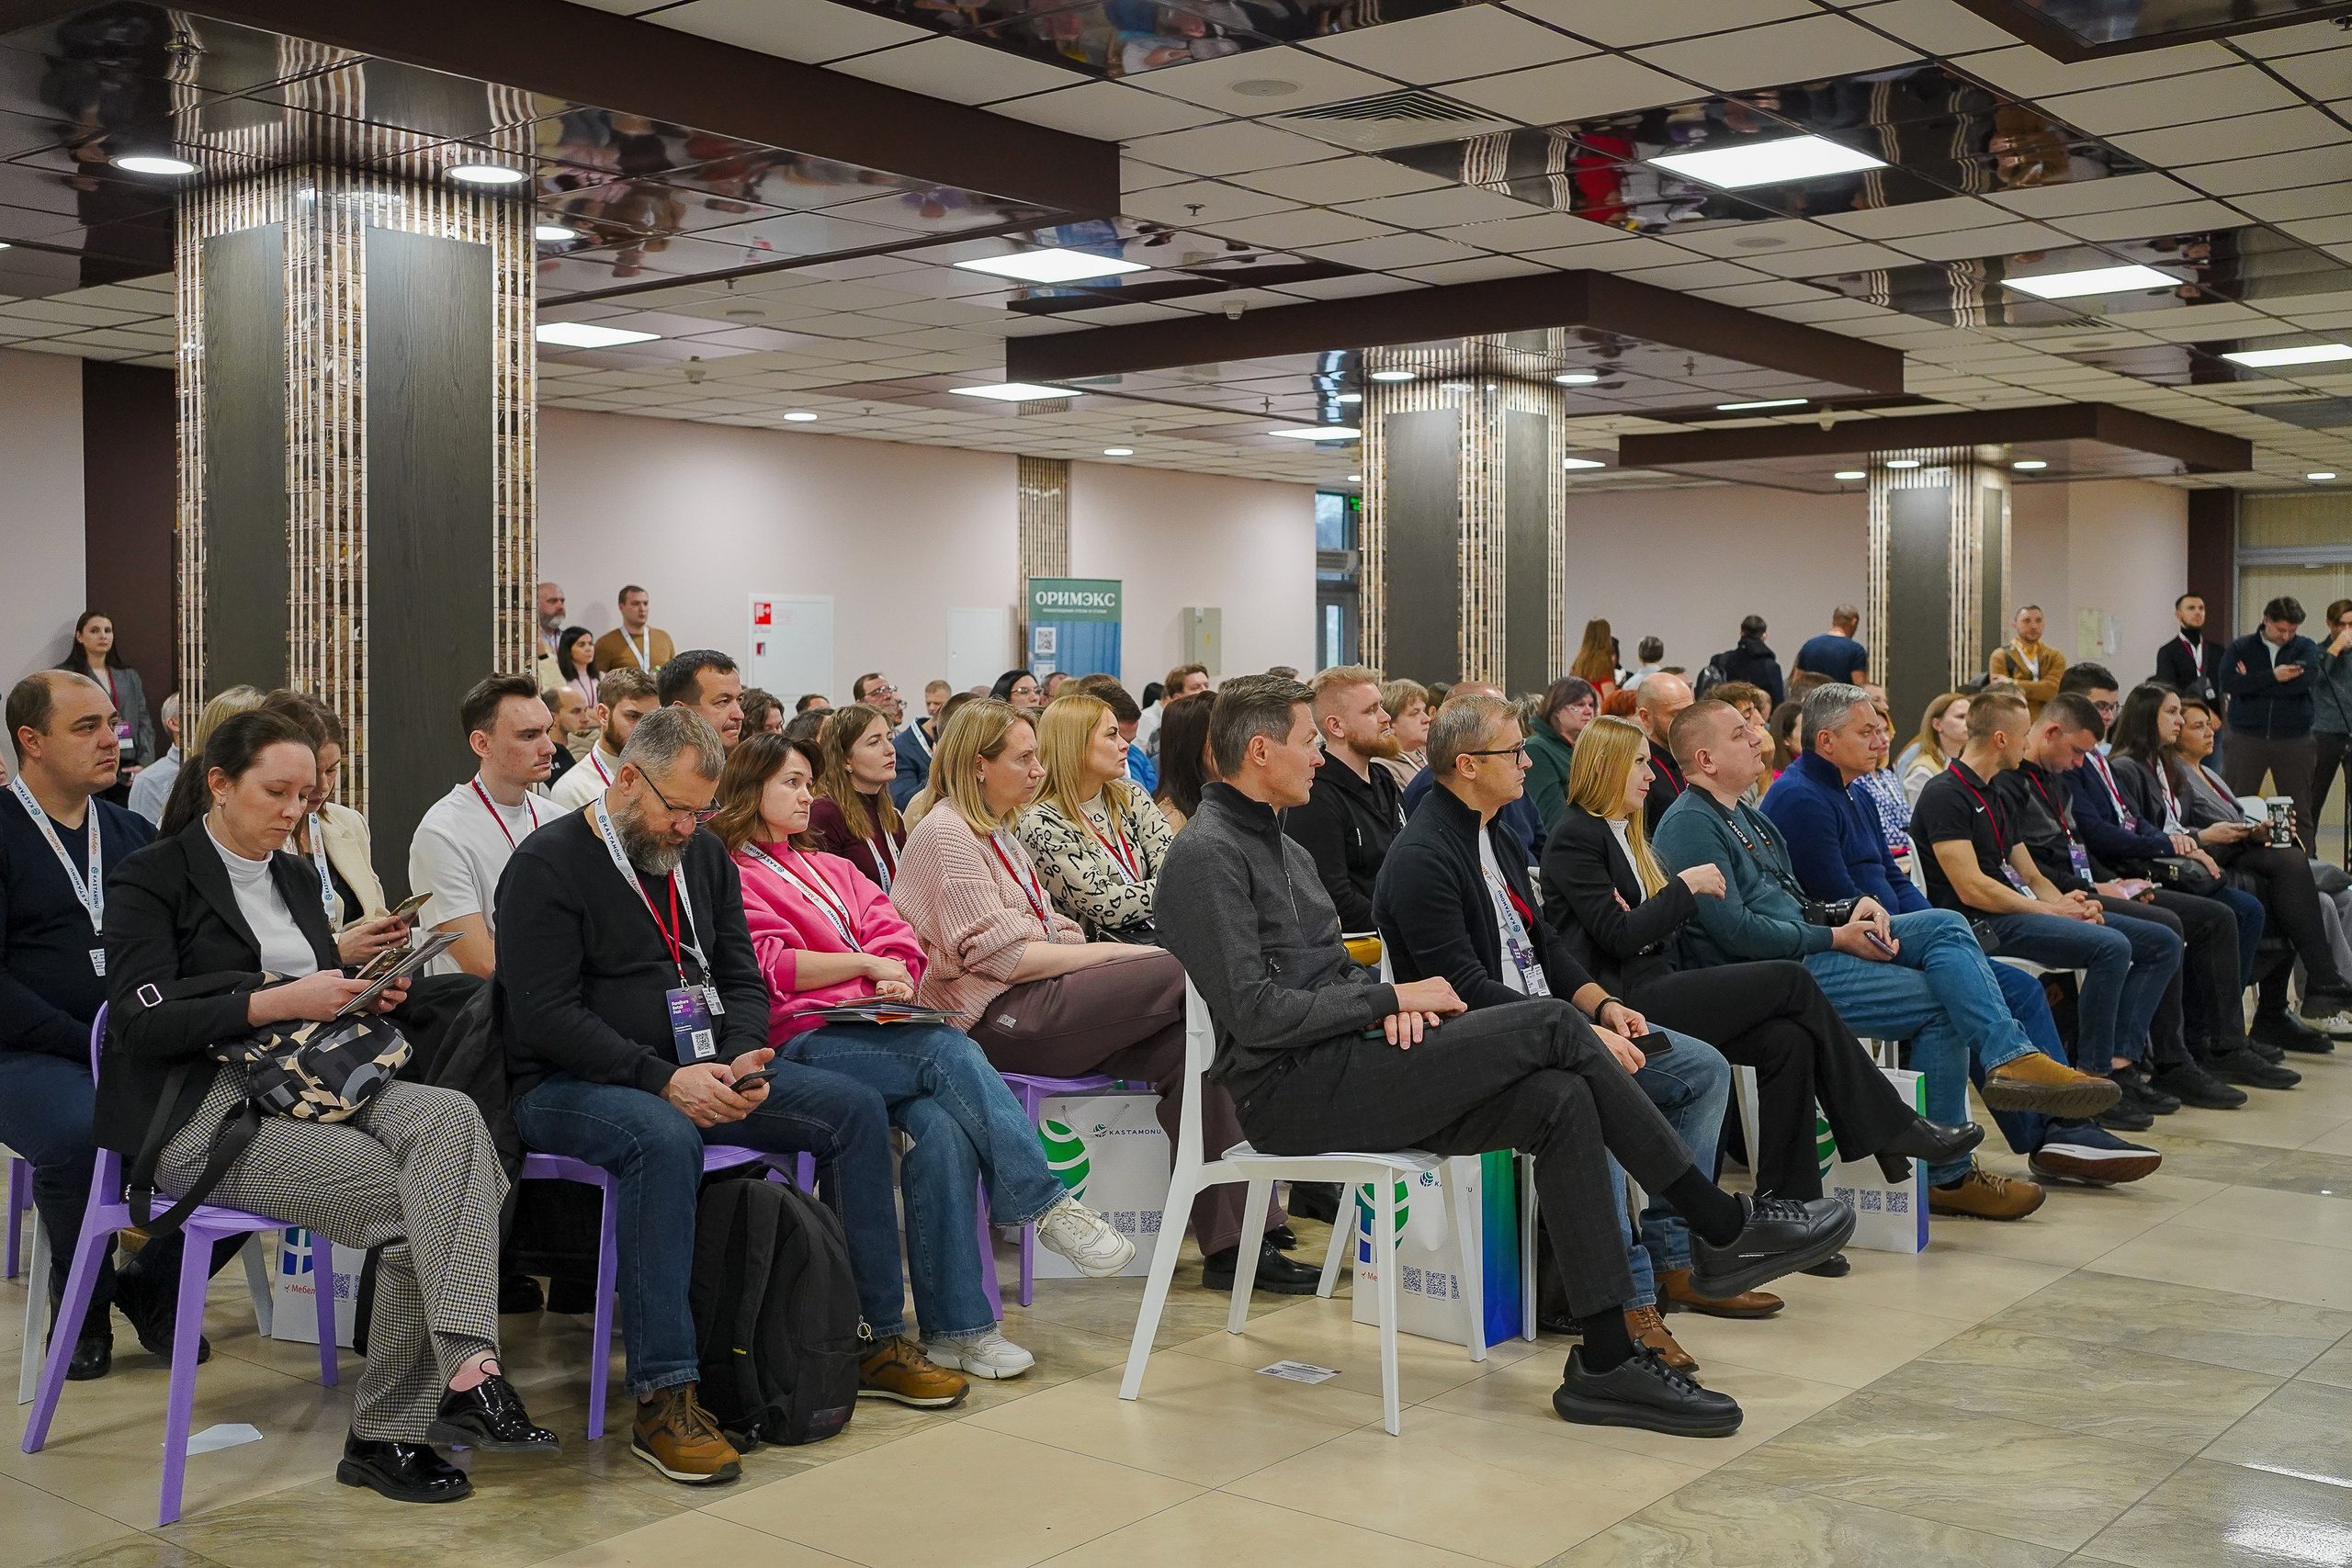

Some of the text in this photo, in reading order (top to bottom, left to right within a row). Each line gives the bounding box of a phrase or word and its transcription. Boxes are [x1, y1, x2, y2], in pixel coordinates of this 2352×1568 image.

[1035, 591, 1116, 607] ОРИМЭКС
[46, 827, 62, 852] Мебель
[603, 822, 624, 862] KASTAMONU
[1727, 819, 1749, 844] SONY
[1497, 889, 1516, 925] KASTAMONU
[291, 1284, 315, 1295] Мебел
